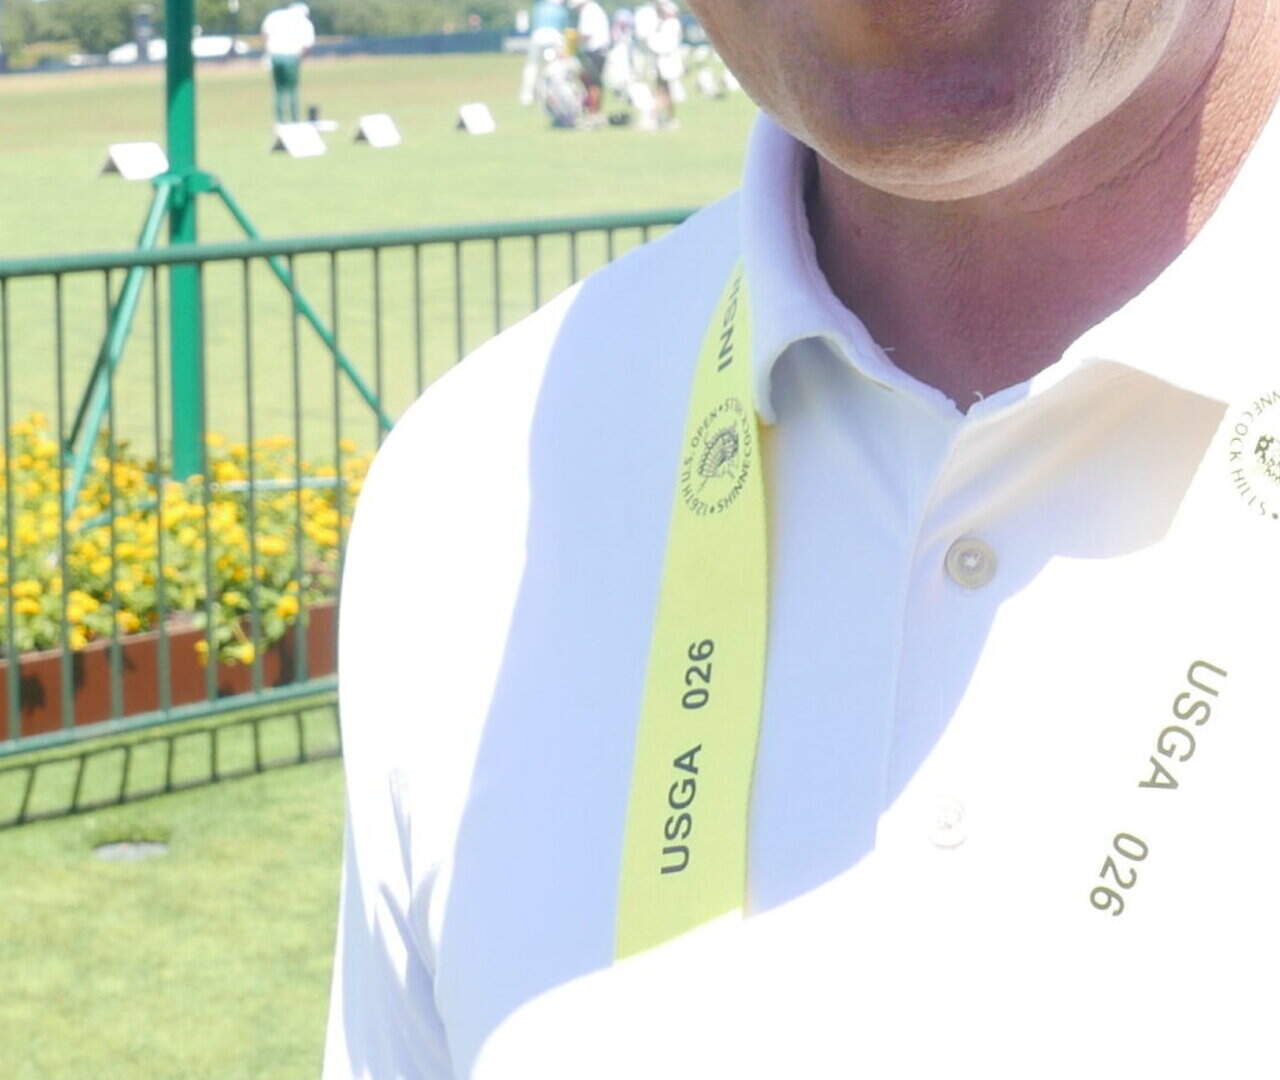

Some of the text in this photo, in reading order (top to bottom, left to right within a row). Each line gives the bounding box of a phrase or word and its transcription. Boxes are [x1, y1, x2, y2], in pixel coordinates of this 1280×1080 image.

[661, 639, 714, 874] USGA 026
[1089, 660, 1228, 917] USGA 026
